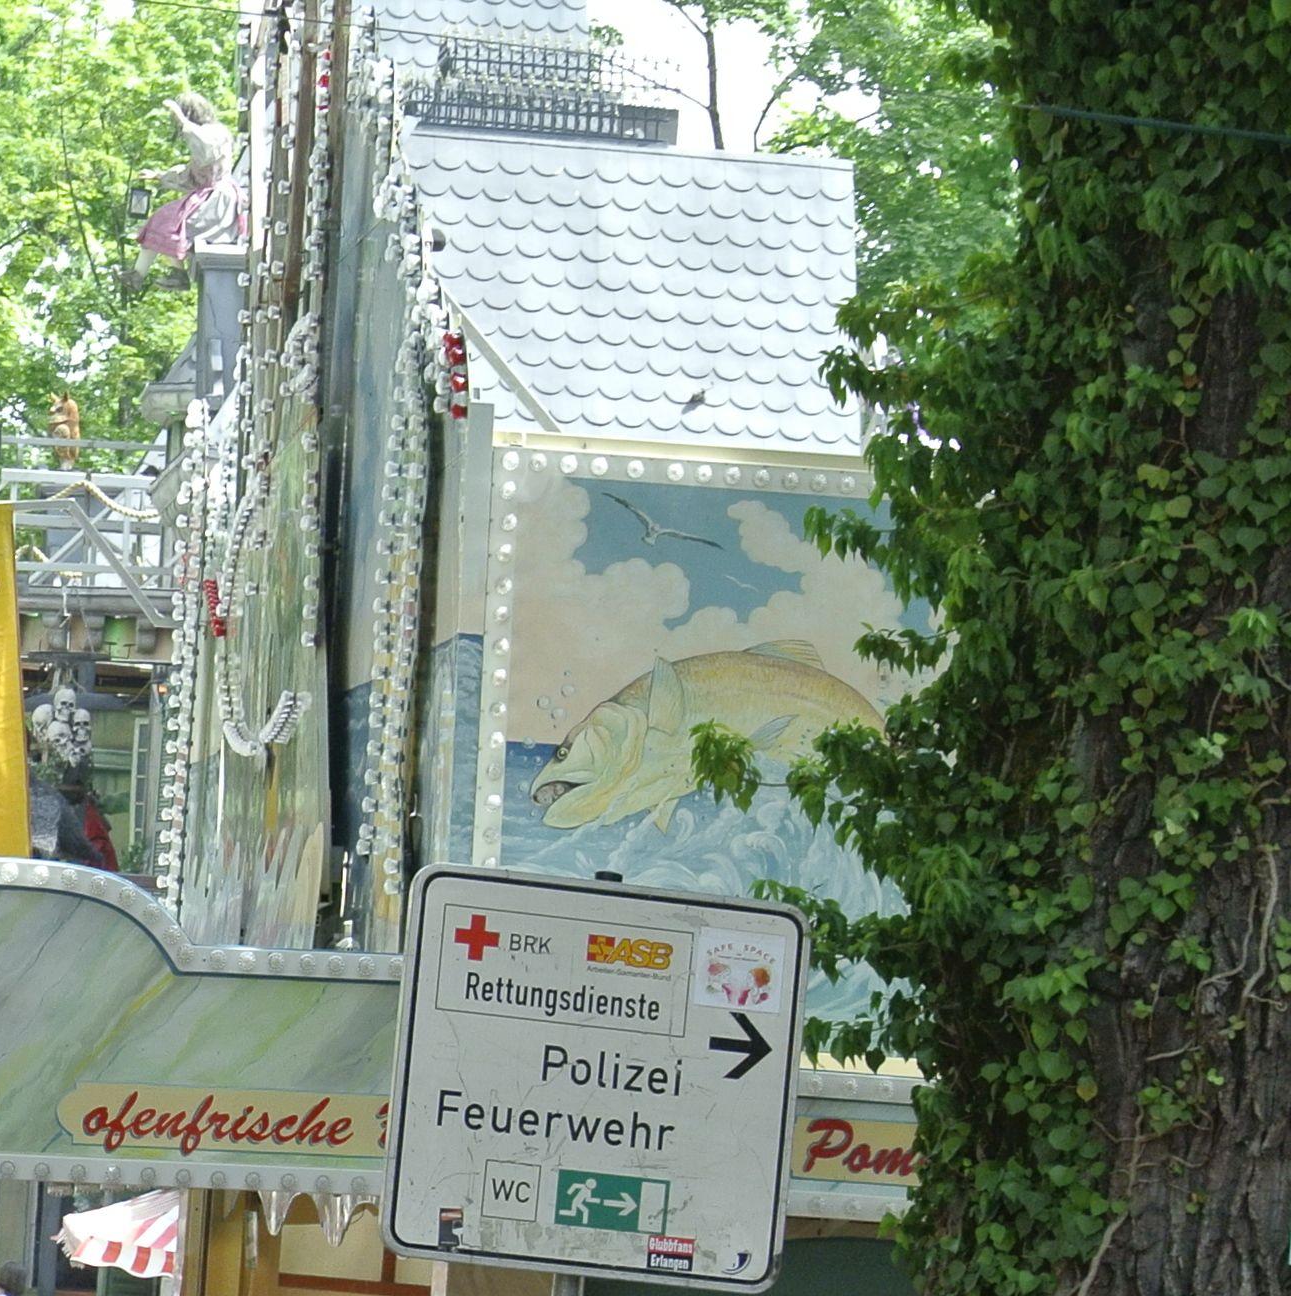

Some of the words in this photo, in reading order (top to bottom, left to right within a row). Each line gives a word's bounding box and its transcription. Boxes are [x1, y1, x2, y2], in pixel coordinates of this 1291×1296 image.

[509, 932, 552, 955] BRK
[607, 937, 674, 971] ASB
[707, 943, 733, 957] SAFE
[743, 944, 776, 965] SPACE
[464, 972, 660, 1021] Rettungsdienste
[541, 1045, 683, 1096] Polizei
[82, 1091, 354, 1156] ofenfrische
[437, 1090, 676, 1151] Feuerwehr
[803, 1118, 925, 1177] Pom
[490, 1176, 532, 1204] WC
[649, 1237, 693, 1253] Glubbfans
[650, 1254, 689, 1271] Erlangen
